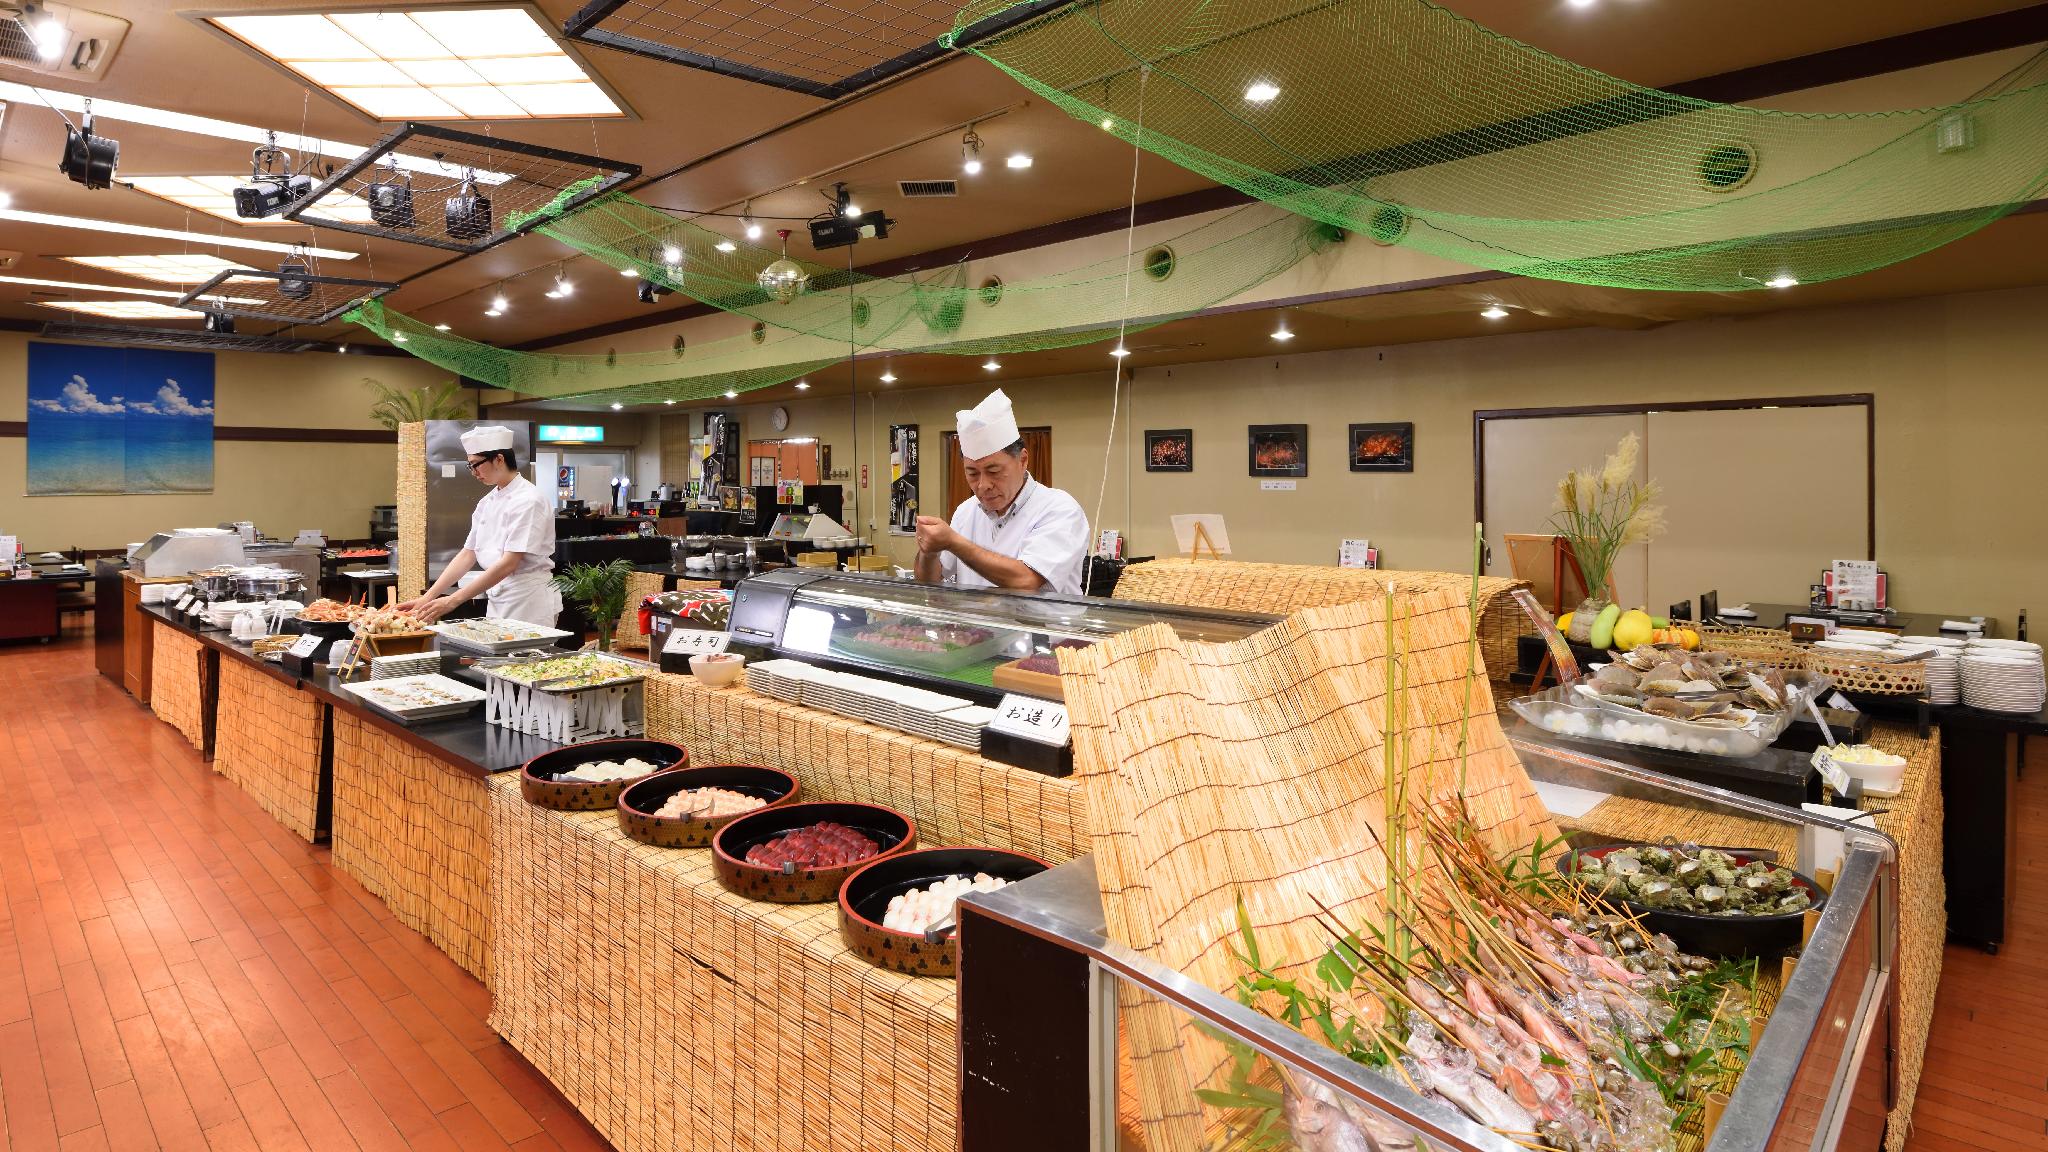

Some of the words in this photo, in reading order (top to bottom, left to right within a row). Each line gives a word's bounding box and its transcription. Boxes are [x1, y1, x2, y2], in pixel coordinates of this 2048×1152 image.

[1802, 626, 1813, 634] 17
[676, 634, 720, 648] お寿司
[1006, 706, 1063, 729] お造り
